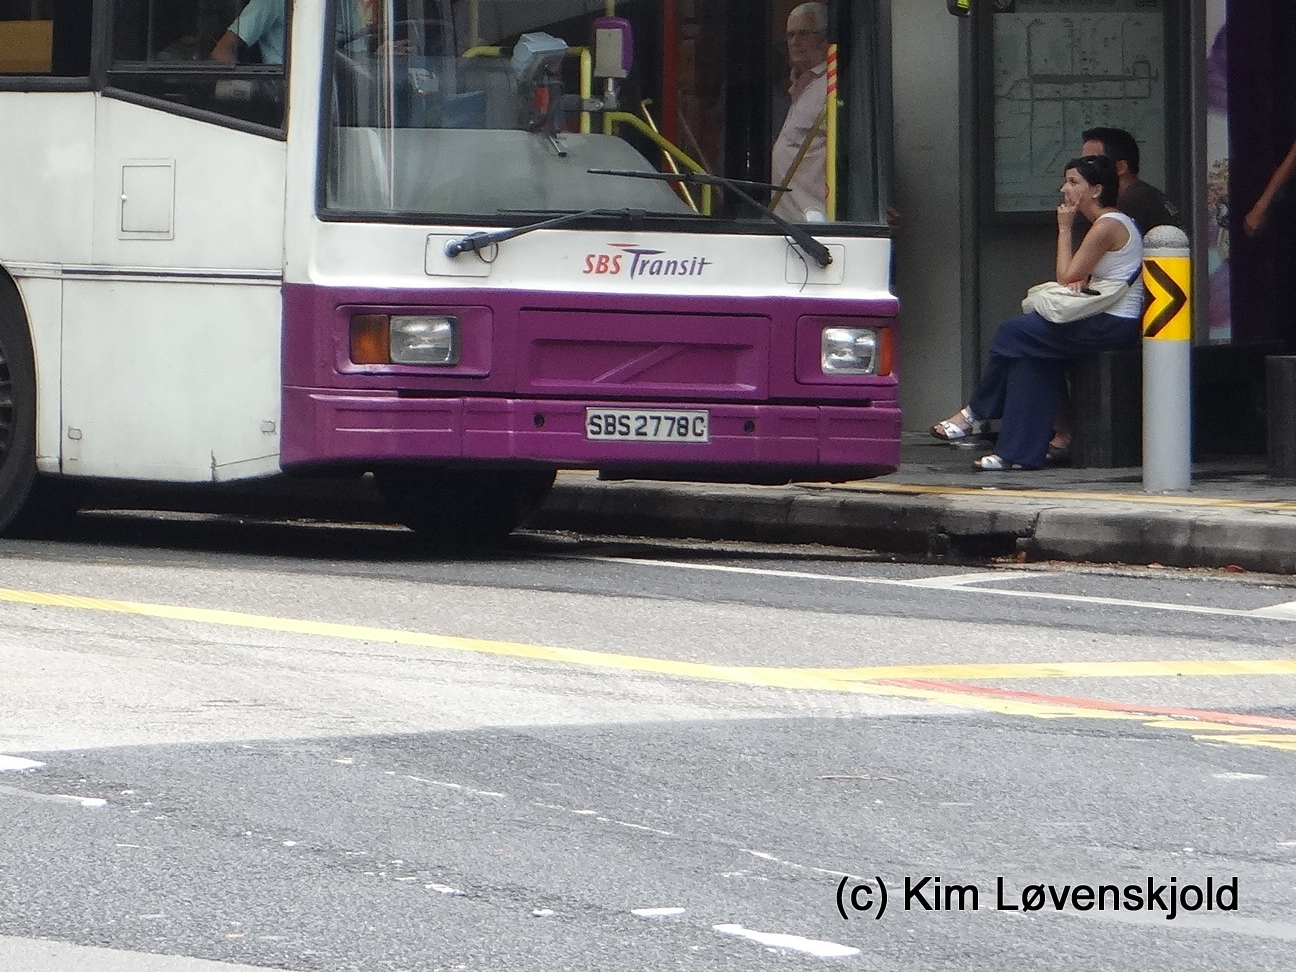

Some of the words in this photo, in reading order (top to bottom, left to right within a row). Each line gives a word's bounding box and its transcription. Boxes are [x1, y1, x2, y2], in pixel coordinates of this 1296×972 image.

[582, 254, 622, 275] SBS
[621, 248, 713, 280] Transit
[589, 414, 705, 437] SBS2778C
